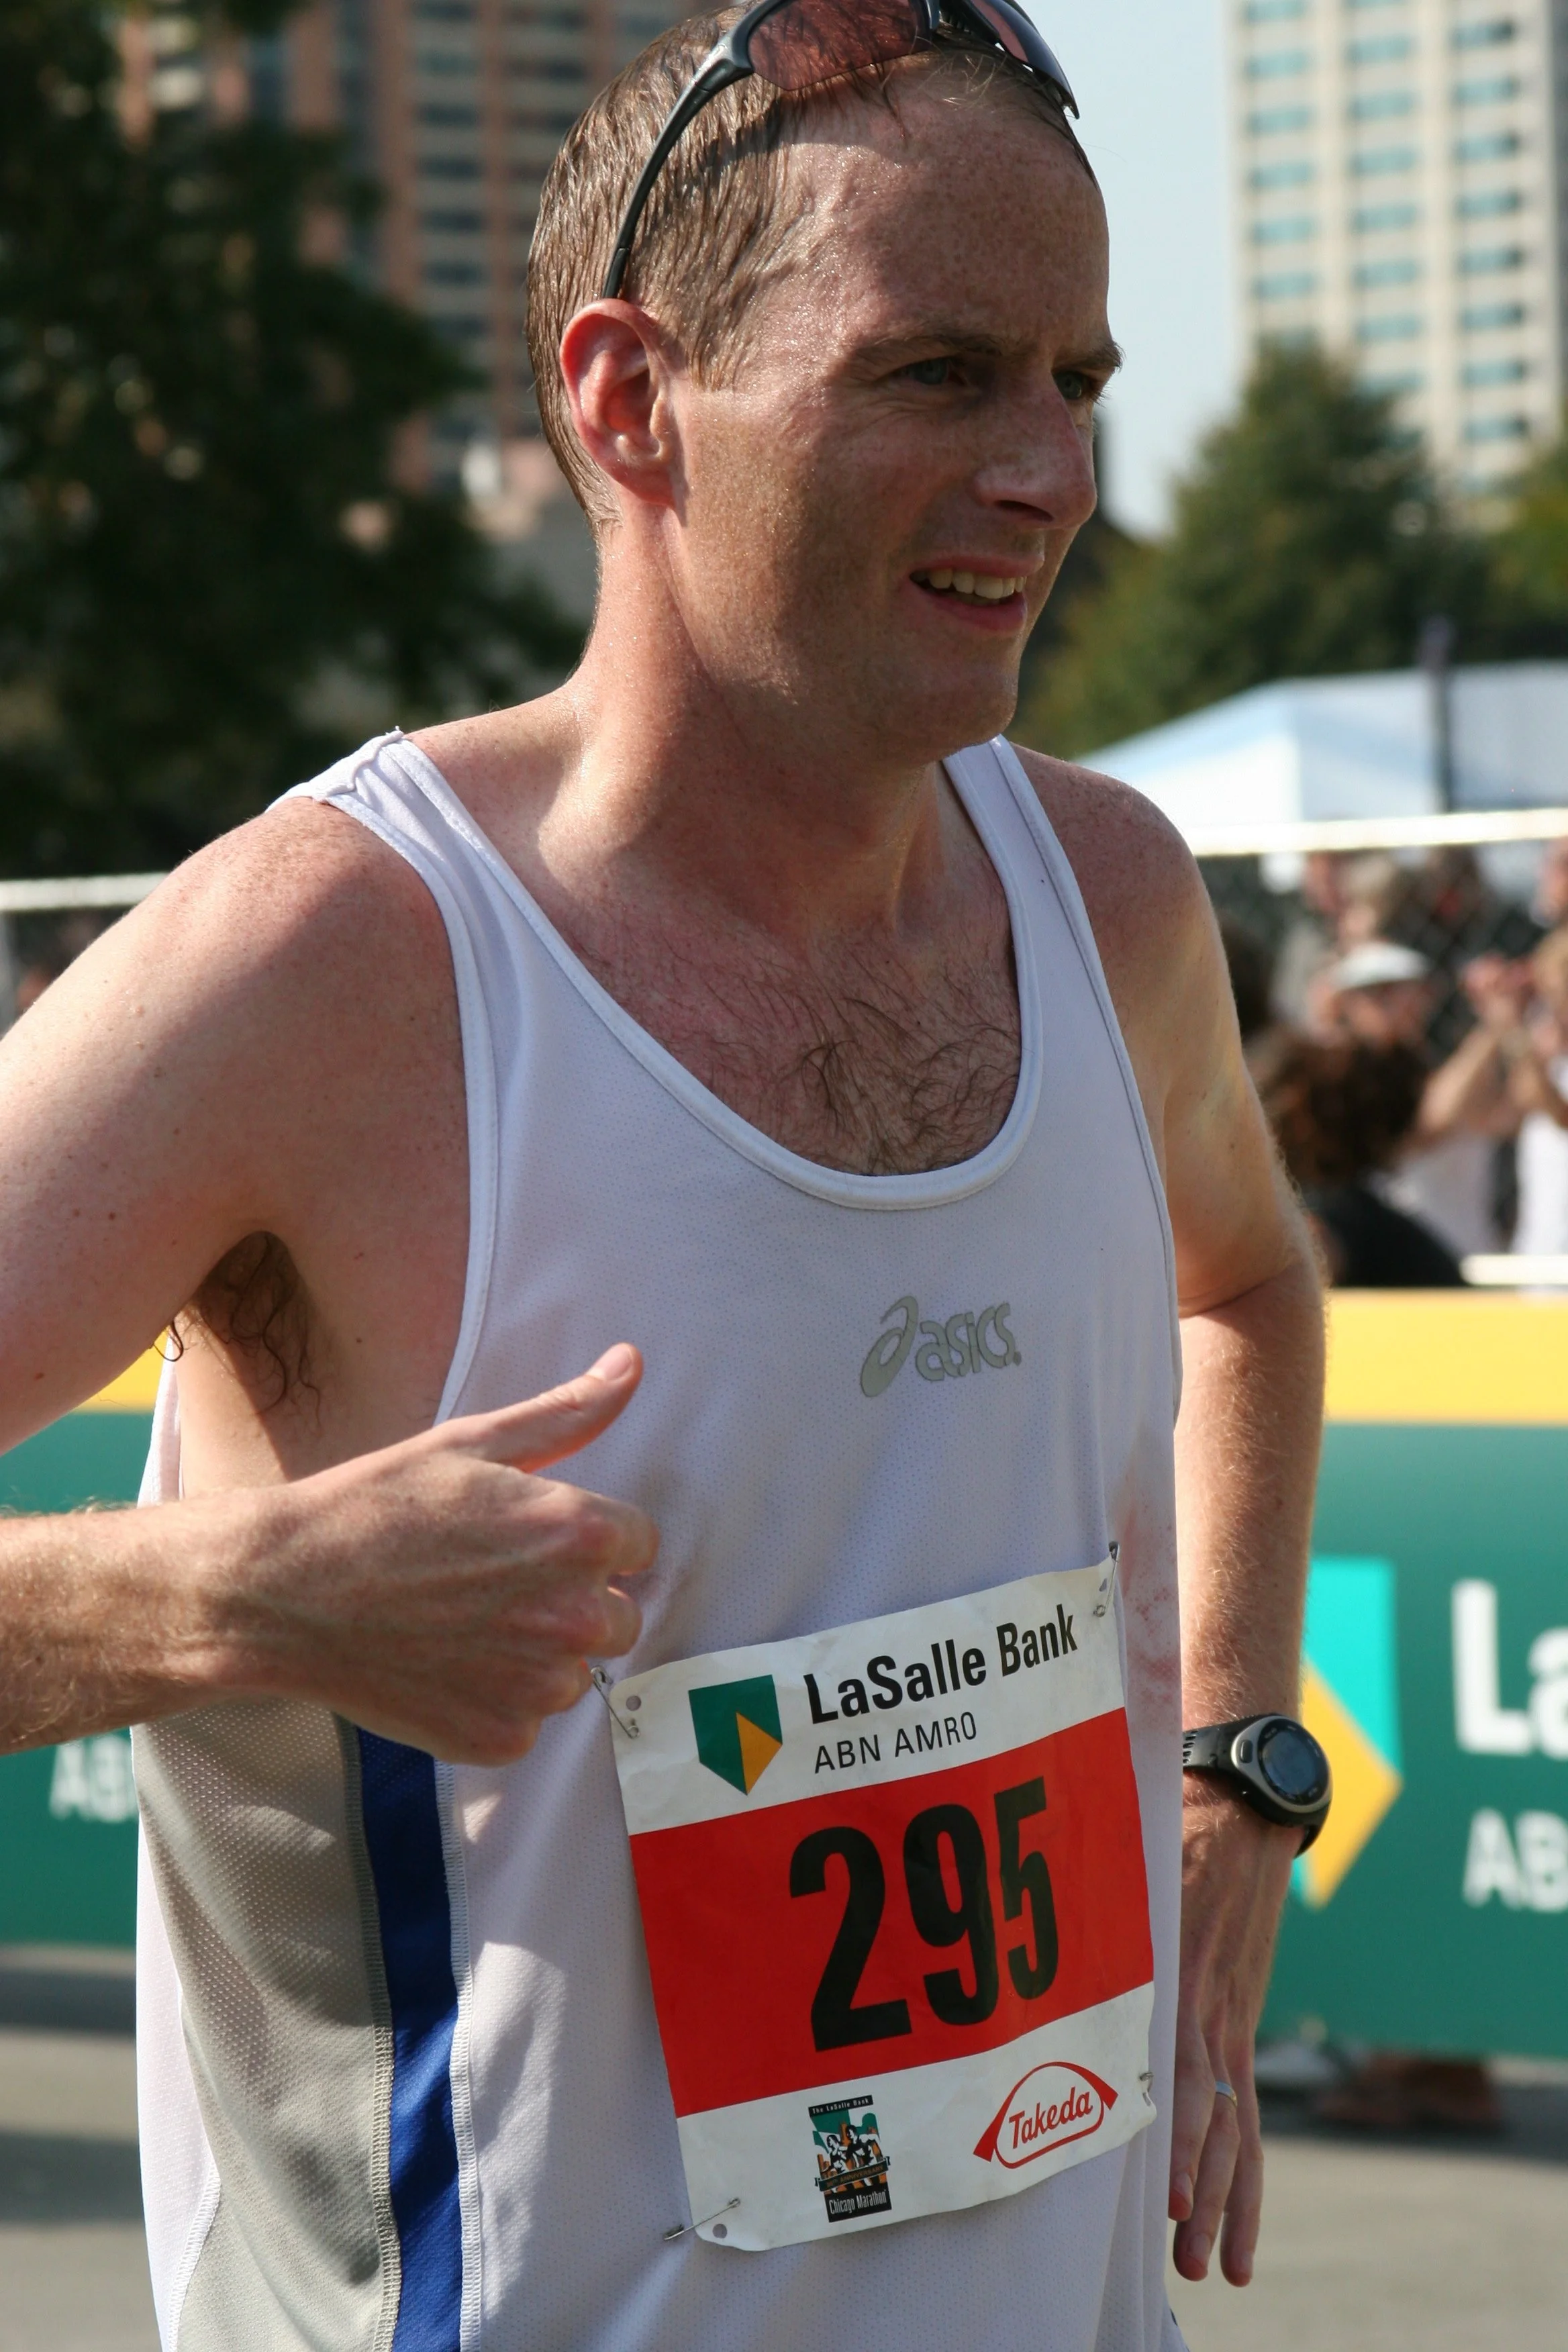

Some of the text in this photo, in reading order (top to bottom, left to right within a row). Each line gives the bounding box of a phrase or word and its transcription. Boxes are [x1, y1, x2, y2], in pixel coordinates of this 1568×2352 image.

[803, 1604, 1078, 1724] LaSalle Bank
[814, 1711, 977, 1774] ABN AMRO
[789, 1775, 1059, 2053] 295
[826, 2102, 851, 2112] LaSalle
[852, 2098, 869, 2106] Bank
[1008, 2086, 1093, 2150] Takeda
[828, 2190, 887, 2214] Chicago Marathon
